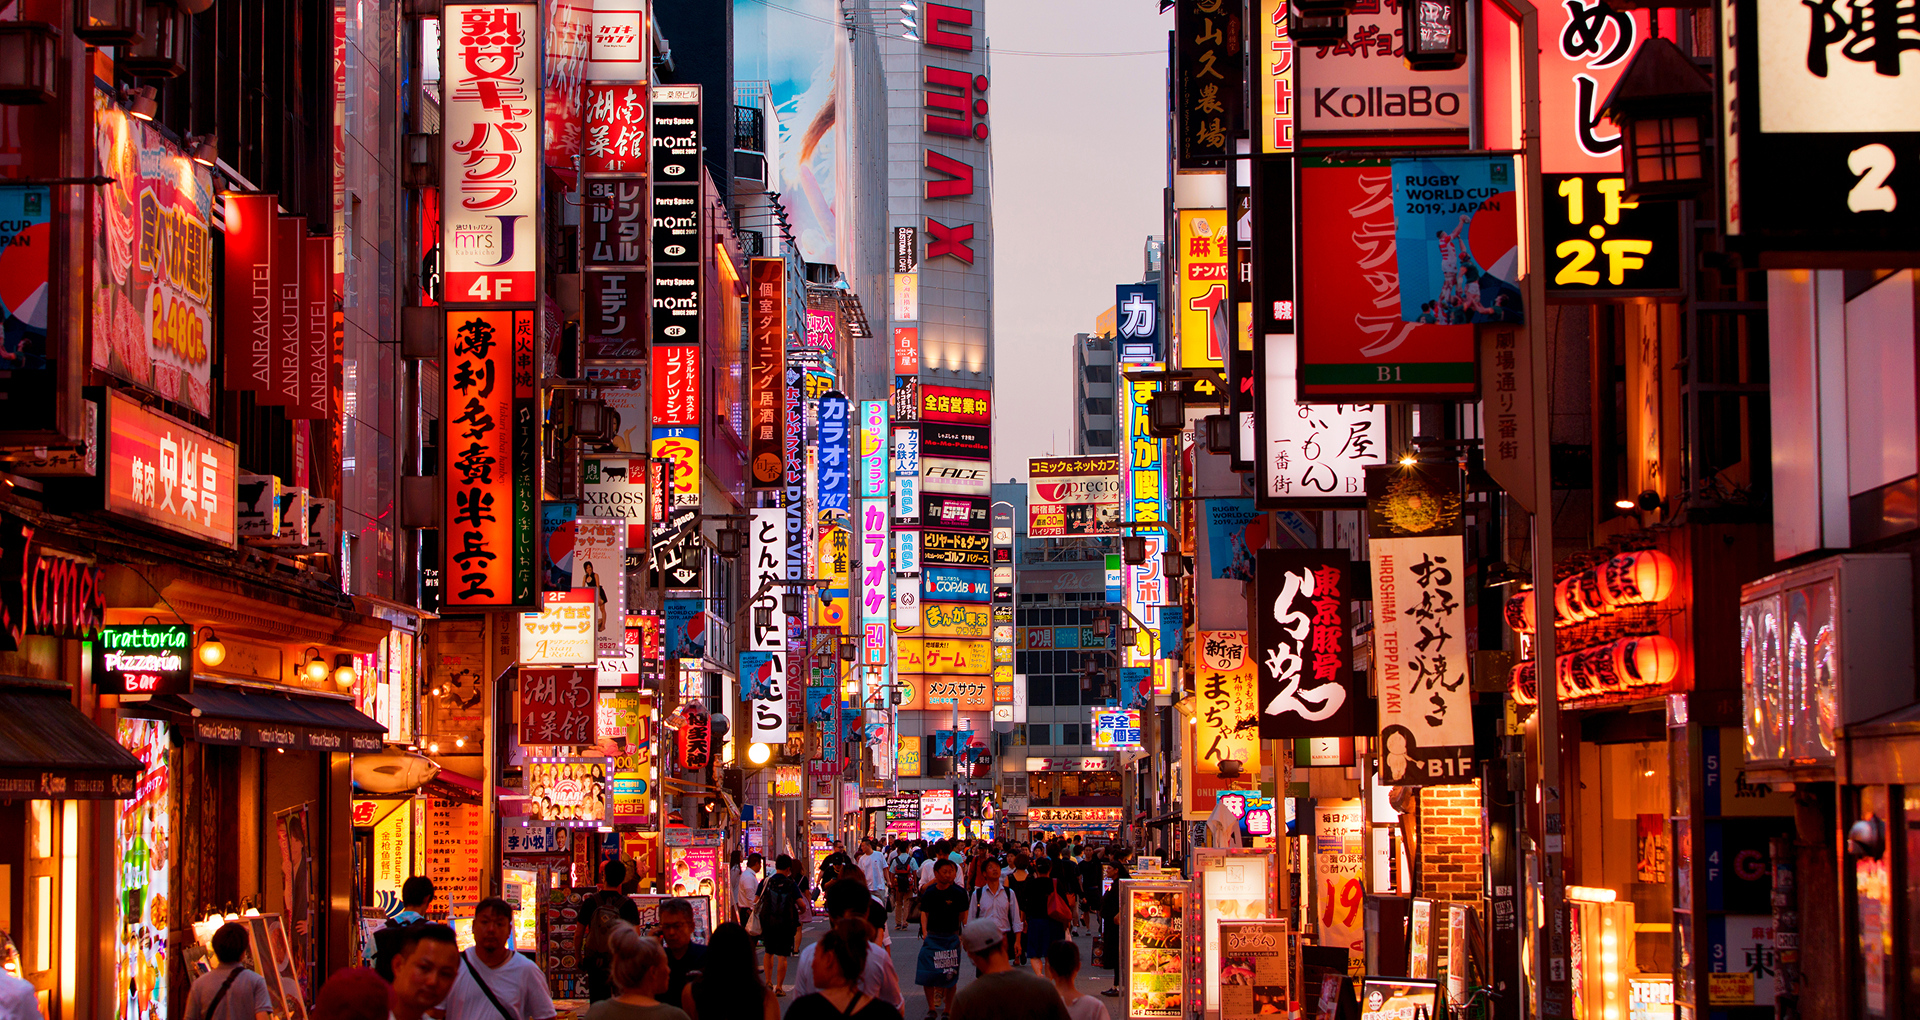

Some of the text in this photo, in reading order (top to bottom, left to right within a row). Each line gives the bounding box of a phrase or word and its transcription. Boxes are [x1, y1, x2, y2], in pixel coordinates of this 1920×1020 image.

[600, 24, 633, 34] カブキ
[594, 34, 637, 44] ラウンジ
[1195, 17, 1226, 149] 山久農場
[452, 8, 532, 211] 熟女キャバクラ
[586, 88, 644, 125] 湖南
[1314, 85, 1460, 118] KollaBo
[656, 118, 694, 126] Party Space
[586, 126, 644, 159] 菜館
[604, 160, 626, 171] 4F
[669, 166, 681, 174] 5F
[1405, 175, 1460, 187] RUGBY
[1847, 143, 1898, 214] 2
[656, 198, 694, 206] Party Space
[1406, 187, 1500, 200] WORLD CUP
[1406, 201, 1502, 216] 2019, JAPAN
[0, 220, 31, 232] CUP
[618, 182, 640, 262] レンタル
[592, 203, 615, 261] ルーム
[669, 246, 681, 254] 4F
[1555, 239, 1654, 286] 2F
[468, 275, 512, 300] 4F
[656, 278, 695, 286] Party Space
[601, 275, 626, 335] エデン
[253, 263, 269, 384] ANRAKUTEI
[669, 327, 681, 335] 3F
[1189, 284, 1227, 362] 1
[282, 283, 298, 400] ANRAKUTEI
[597, 338, 641, 356] Eden
[311, 301, 326, 413] ANRAKUTEI
[516, 319, 533, 388] 炭火串焼
[901, 337, 917, 366] 白木屋
[686, 348, 695, 392] レンタルルーム
[758, 281, 774, 441] 個室ダイニング居酒屋
[1376, 366, 1403, 382] B1
[666, 348, 681, 423] リフレッシュ
[924, 394, 987, 416] 全店営業中
[499, 401, 508, 451] Hakuri tabai
[667, 428, 684, 437] 1F
[822, 397, 846, 491] カラオケ
[908, 430, 918, 470] カラオケ
[925, 439, 988, 450] Mo-Mo-Paradise
[897, 443, 907, 470] の鉄人
[588, 463, 597, 473] 肉
[926, 467, 988, 480] FACE
[1031, 460, 1119, 473] コミック&ネットカフ
[1272, 439, 1293, 494] 一番街
[132, 455, 156, 509] 焼肉
[585, 492, 643, 505] XROSS
[675, 494, 698, 504] 天神
[821, 493, 845, 507] 747
[901, 479, 913, 515] SEGA
[592, 505, 638, 518] CASA
[1031, 505, 1064, 514] 新宿最大
[580, 526, 615, 536] タイ古式
[924, 534, 989, 550] ビリヤード&ダーツ
[833, 529, 847, 574] 麻雀
[865, 504, 886, 615] カラオケ
[901, 533, 913, 570] SEGA
[944, 551, 989, 564] ゴルフ バグース
[936, 581, 988, 594] COPABOWL
[1379, 555, 1397, 624] HIROSHIMA
[549, 593, 566, 601] 2F
[541, 606, 591, 619] タイ古式
[926, 606, 988, 627] まんが喫茶
[524, 621, 591, 634] マッサージ
[956, 627, 983, 636] ゲラゲラ
[1311, 563, 1343, 682] 東京豚骨
[1030, 629, 1051, 647] つり具
[1056, 630, 1077, 647] Fishing
[1404, 552, 1465, 728] お好み焼き
[527, 639, 572, 662] Asian
[926, 650, 967, 668] ゲーム
[123, 674, 161, 691] Bar
[524, 671, 591, 708] 湖南
[929, 683, 987, 696] メンズサウナ
[1100, 715, 1129, 729] 完全
[1204, 672, 1233, 762] まっちゃん
[523, 711, 535, 742] 4F
[538, 711, 591, 743] 菜館
[1113, 728, 1141, 742] 個室
[1041, 758, 1108, 770] コーヒー ショップ
[1427, 757, 1473, 777] B1F
[1707, 755, 1718, 788] 5F
[923, 804, 952, 815] ゲーム
[1246, 797, 1271, 807] フリー
[507, 834, 545, 850] 李 小牧
[395, 818, 403, 888] Tuna Restaurant
[1708, 850, 1719, 882] 4F
[1228, 934, 1276, 948] うまいもん
